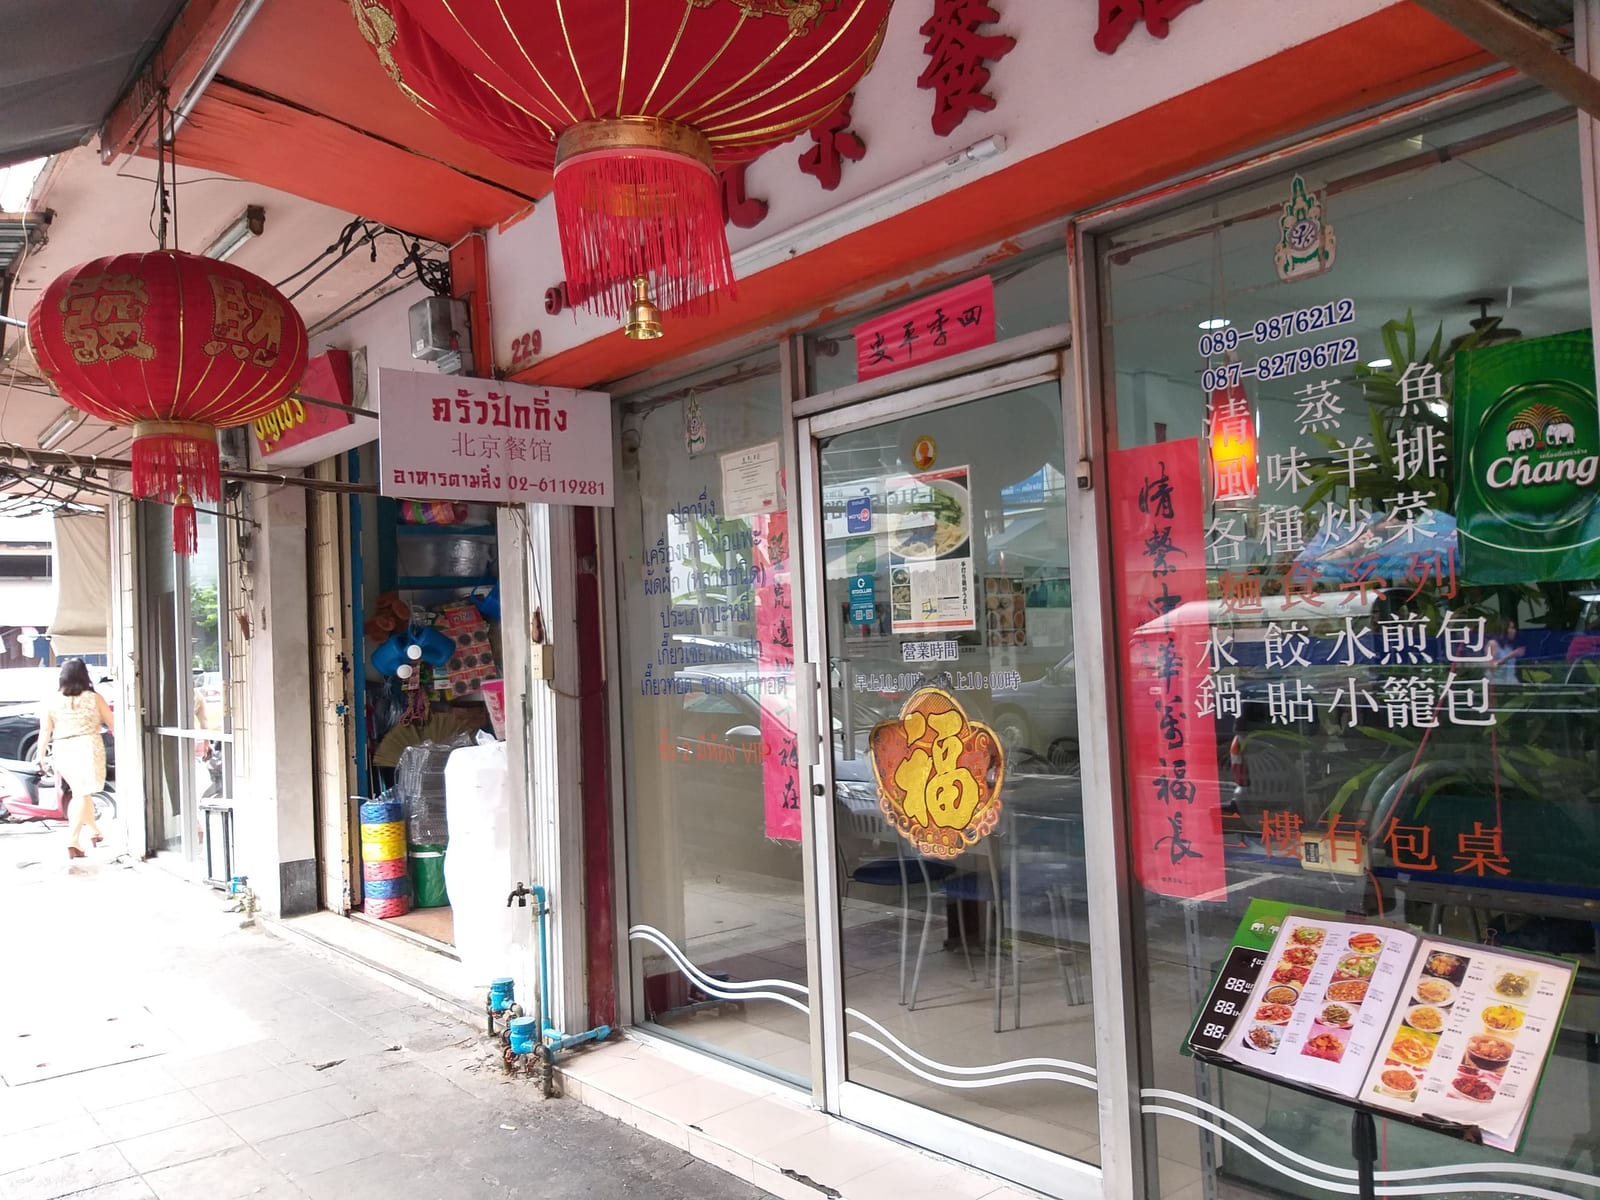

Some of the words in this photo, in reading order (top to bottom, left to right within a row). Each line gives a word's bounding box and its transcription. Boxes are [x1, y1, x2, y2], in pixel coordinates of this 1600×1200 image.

[1199, 298, 1355, 357] 089-9876212
[511, 329, 542, 364] 229
[1201, 338, 1359, 392] 087-8279672
[393, 465, 501, 489] อาหารตามสั่ง
[508, 475, 605, 495] 02-6119281
[1486, 455, 1599, 488] Chang
[742, 742, 771, 764] VIP
